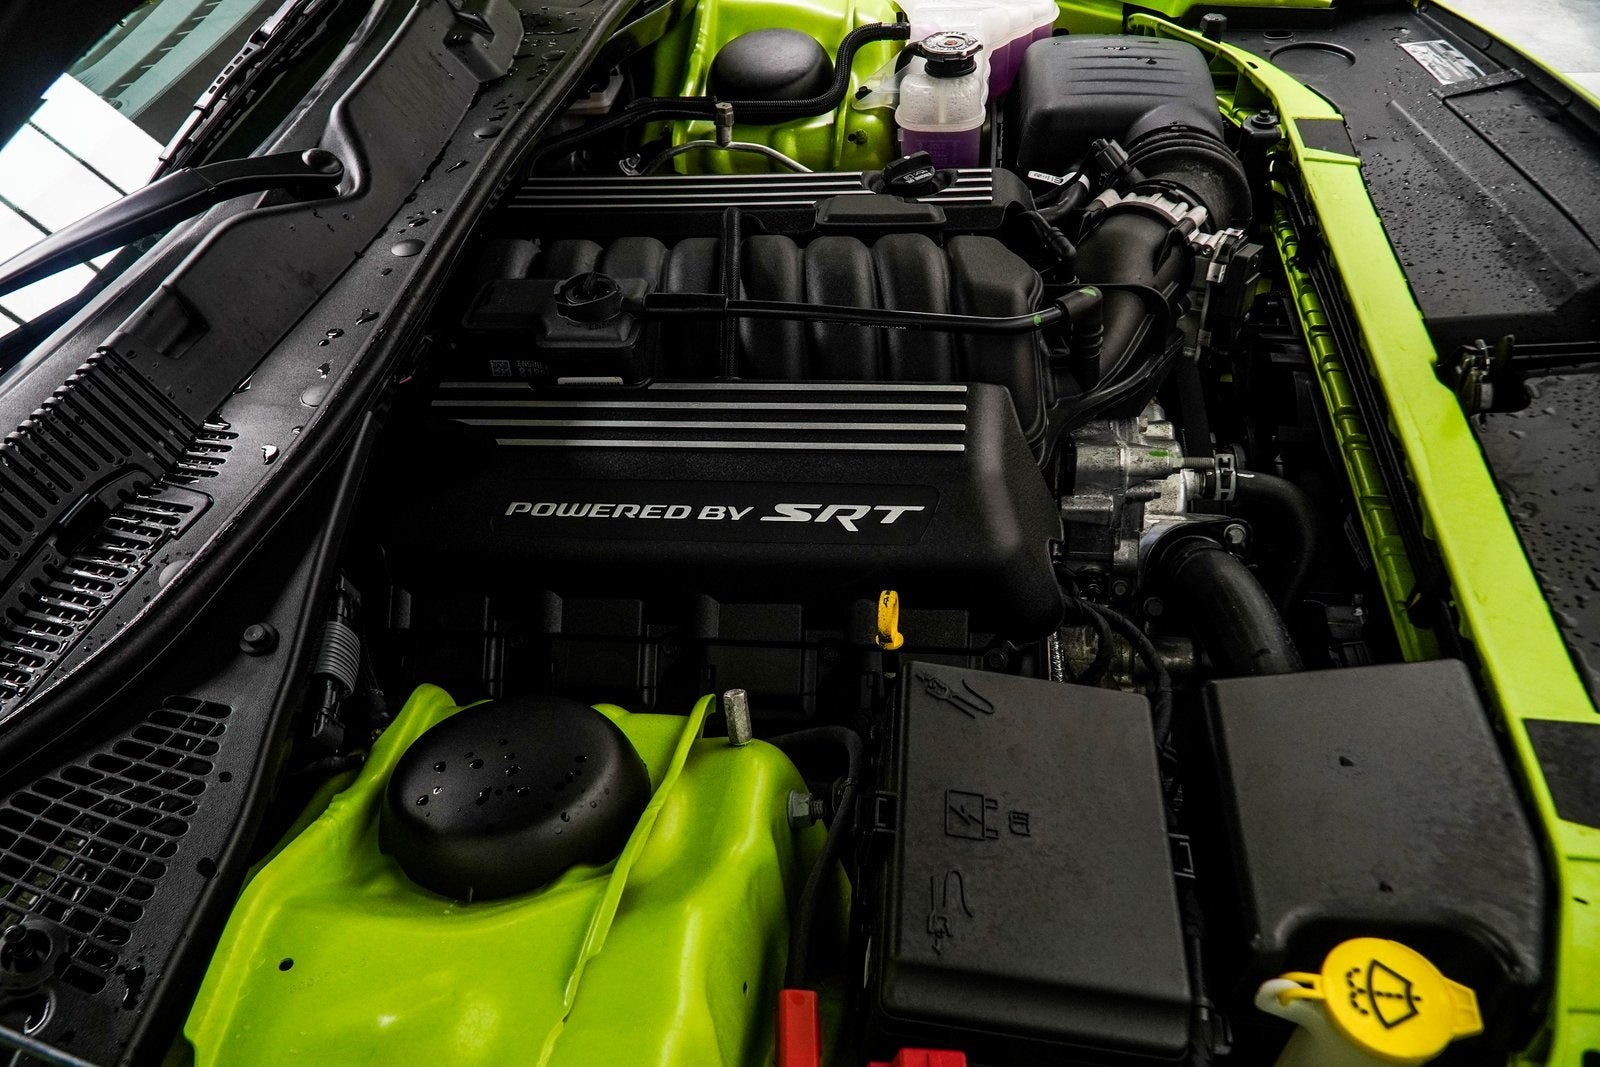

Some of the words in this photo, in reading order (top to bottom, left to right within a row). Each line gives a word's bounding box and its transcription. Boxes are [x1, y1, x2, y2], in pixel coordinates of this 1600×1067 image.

[504, 502, 692, 520] POWERED
[697, 505, 755, 521] BY
[759, 503, 926, 533] SRT
